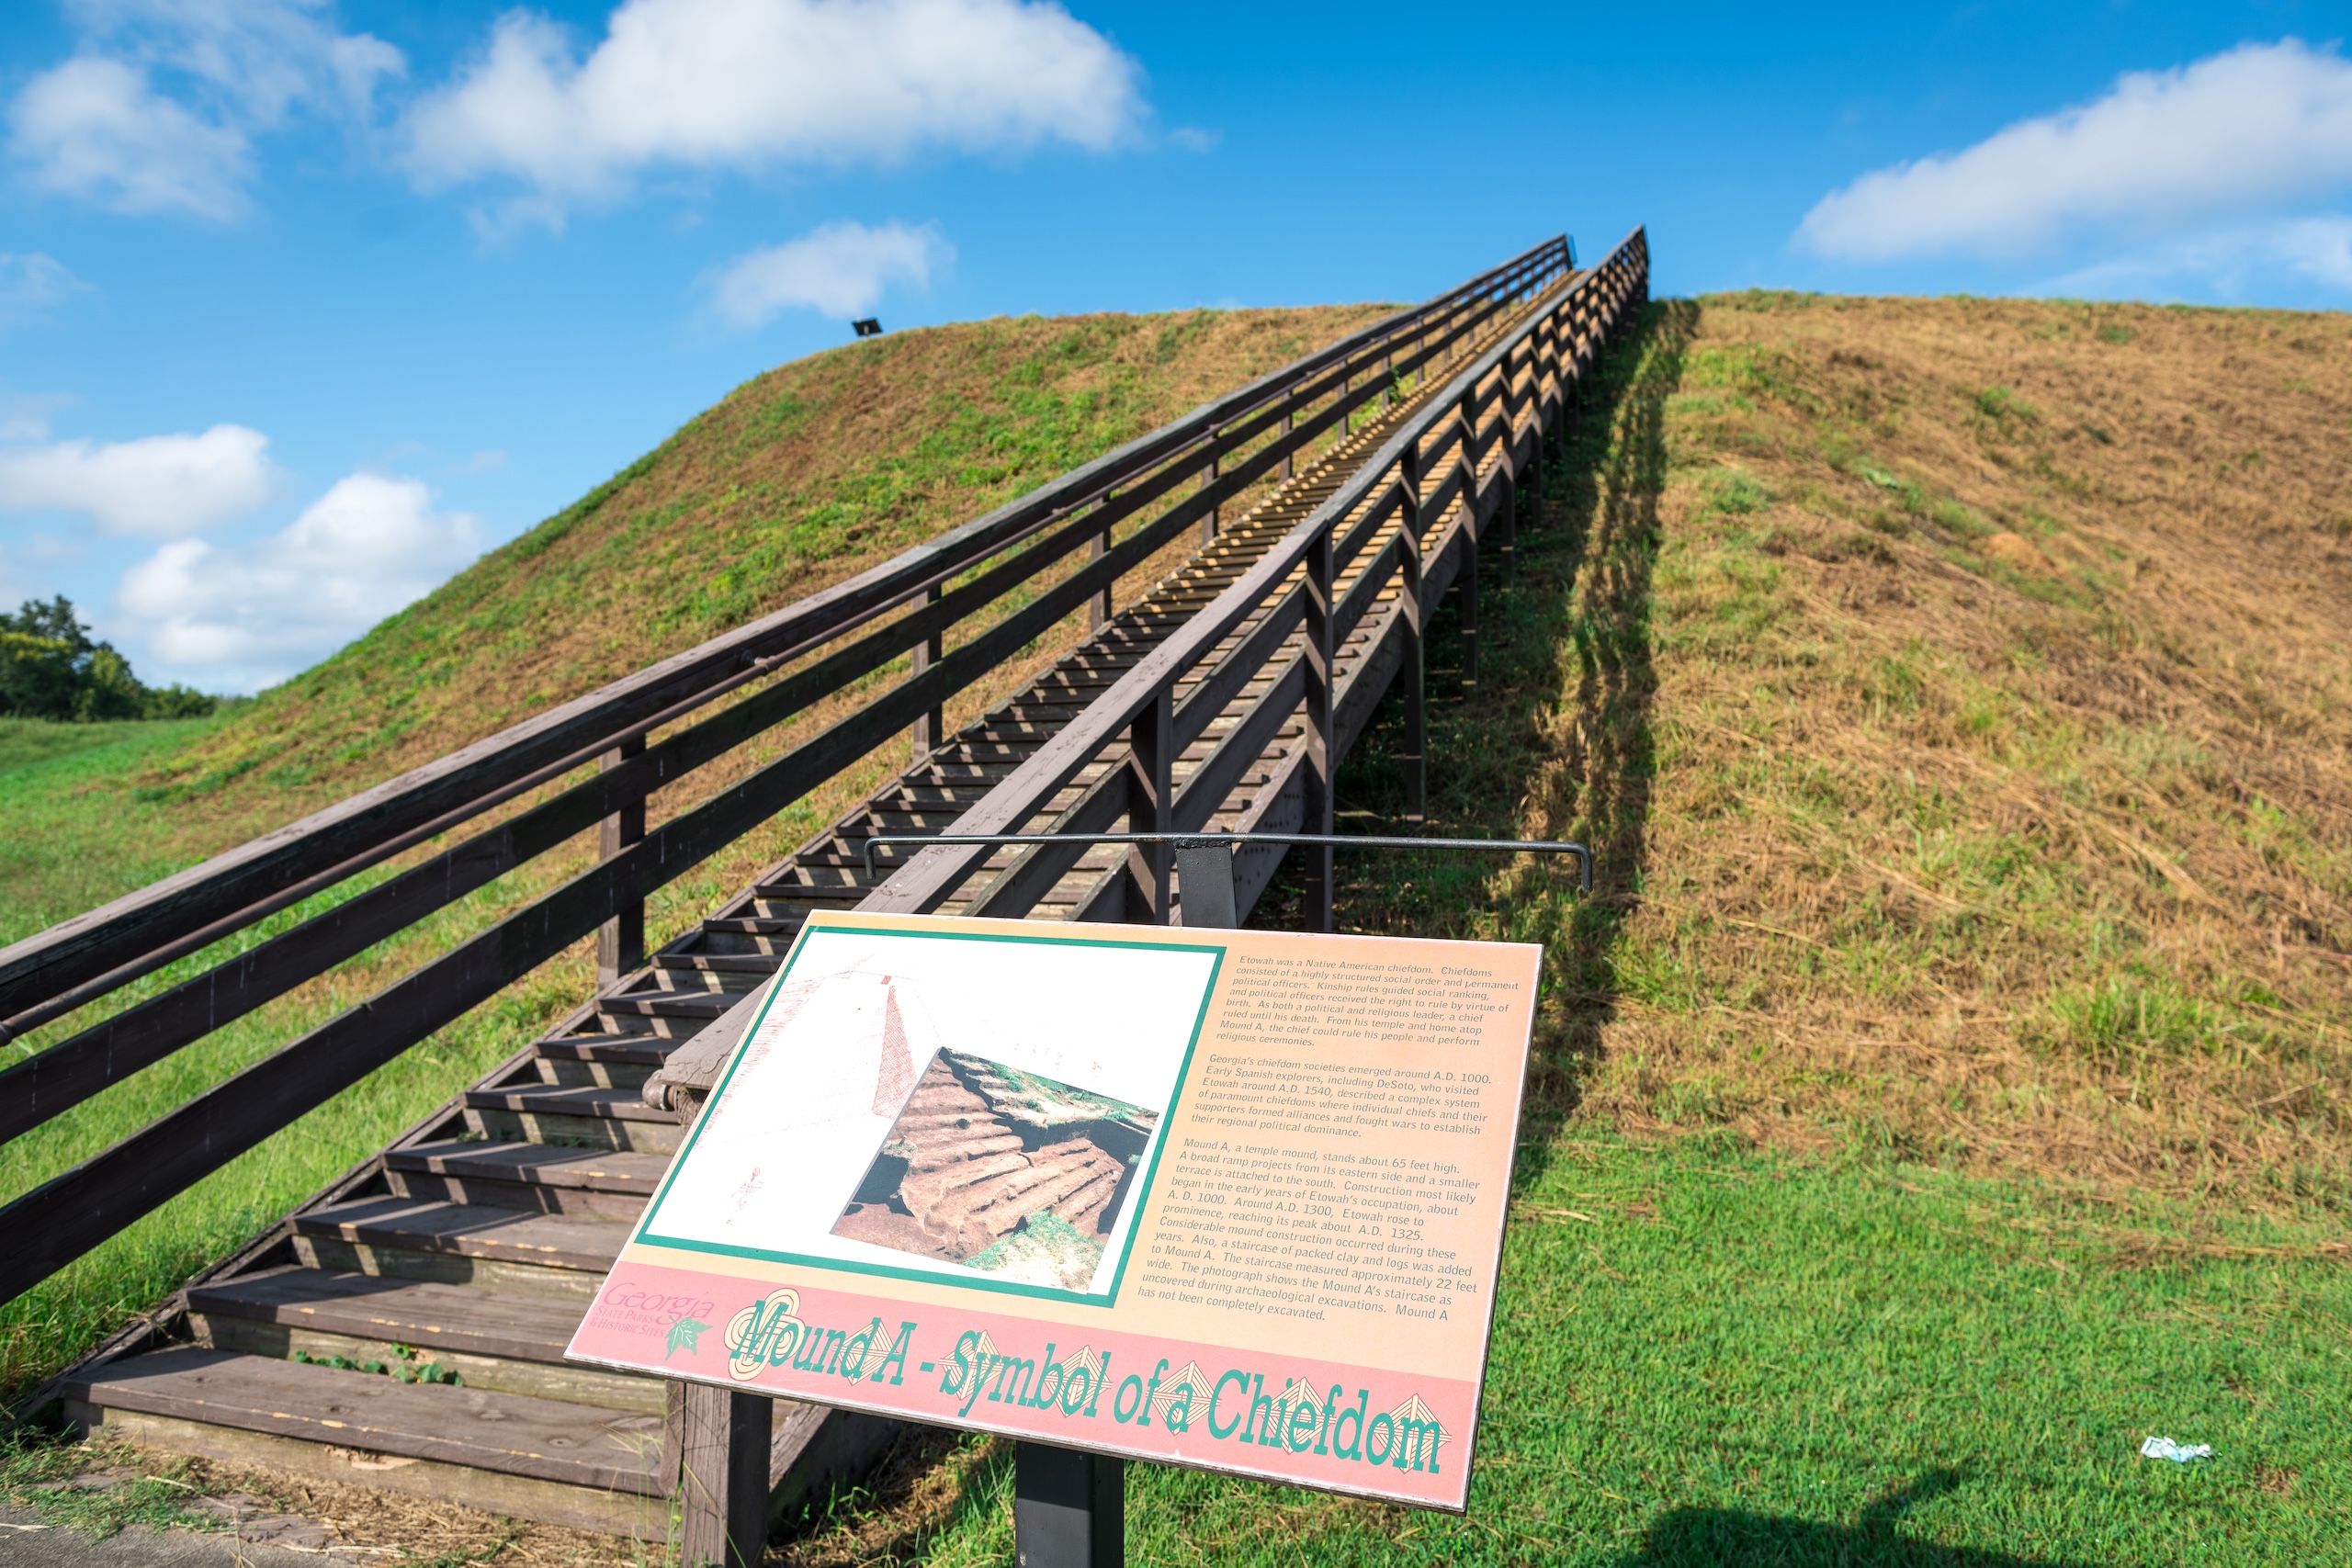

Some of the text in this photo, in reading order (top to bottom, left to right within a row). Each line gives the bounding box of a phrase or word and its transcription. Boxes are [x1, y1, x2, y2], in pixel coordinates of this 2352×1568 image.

[1238, 954, 1274, 965] Etowah
[1305, 958, 1337, 969] Native
[1338, 960, 1385, 972] American
[1386, 963, 1434, 975] chiefdom.
[1440, 965, 1493, 977] Chiefdoms
[1231, 976, 1490, 1001] political officers. Kinship rules guided social ranking,
[1222, 1009, 1483, 1036] ruled until his death. From his temple and home atop
[1225, 998, 1485, 1022] birth. As both a political and religious leader, a chief
[1216, 1031, 1315, 1046] religious ceremonies.
[1204, 1065, 1480, 1096] Early Spanish explorers, including DeSoto, who visited
[1208, 1053, 1492, 1085] Georgia's chiefdom societies emerged around A.D. 1000.
[1201, 1077, 1480, 1109] Etowah around A.D. 1540, described a complex system
[1193, 1102, 1481, 1135] supporters formed alliances and fought wars to establish
[1182, 1137, 1460, 1175] Mound A, a temple mound, stands about 65 feet high.
[1170, 1176, 1459, 1216] began in the early years of Etowah's occupation, about
[1174, 1164, 1476, 1205] terrace is attached to the south. Construction most likely
[1159, 1215, 1456, 1260] Considerable mound construction occurred during these
[1161, 1204, 1423, 1242] prominence, reaching its peak about A.D. 1325.
[1146, 1258, 1452, 1306] wide. The photograph shows the Mound A's staircase as
[1150, 1244, 1477, 1293] to Mound A. The staircase measured approximately 22 feet
[603, 1282, 715, 1325] Georgia
[1136, 1285, 1326, 1321] has not been completely excavated.
[1141, 1273, 1448, 1321] uncovered during archaeological excavations. Mound A
[589, 1317, 603, 1327] &
[730, 1301, 882, 1380] Mound
[870, 1321, 918, 1386] A
[940, 1330, 1113, 1417] Symbol
[1114, 1359, 1170, 1427] of
[1166, 1382, 1193, 1433] a
[1207, 1369, 1442, 1474] Chiefdom
